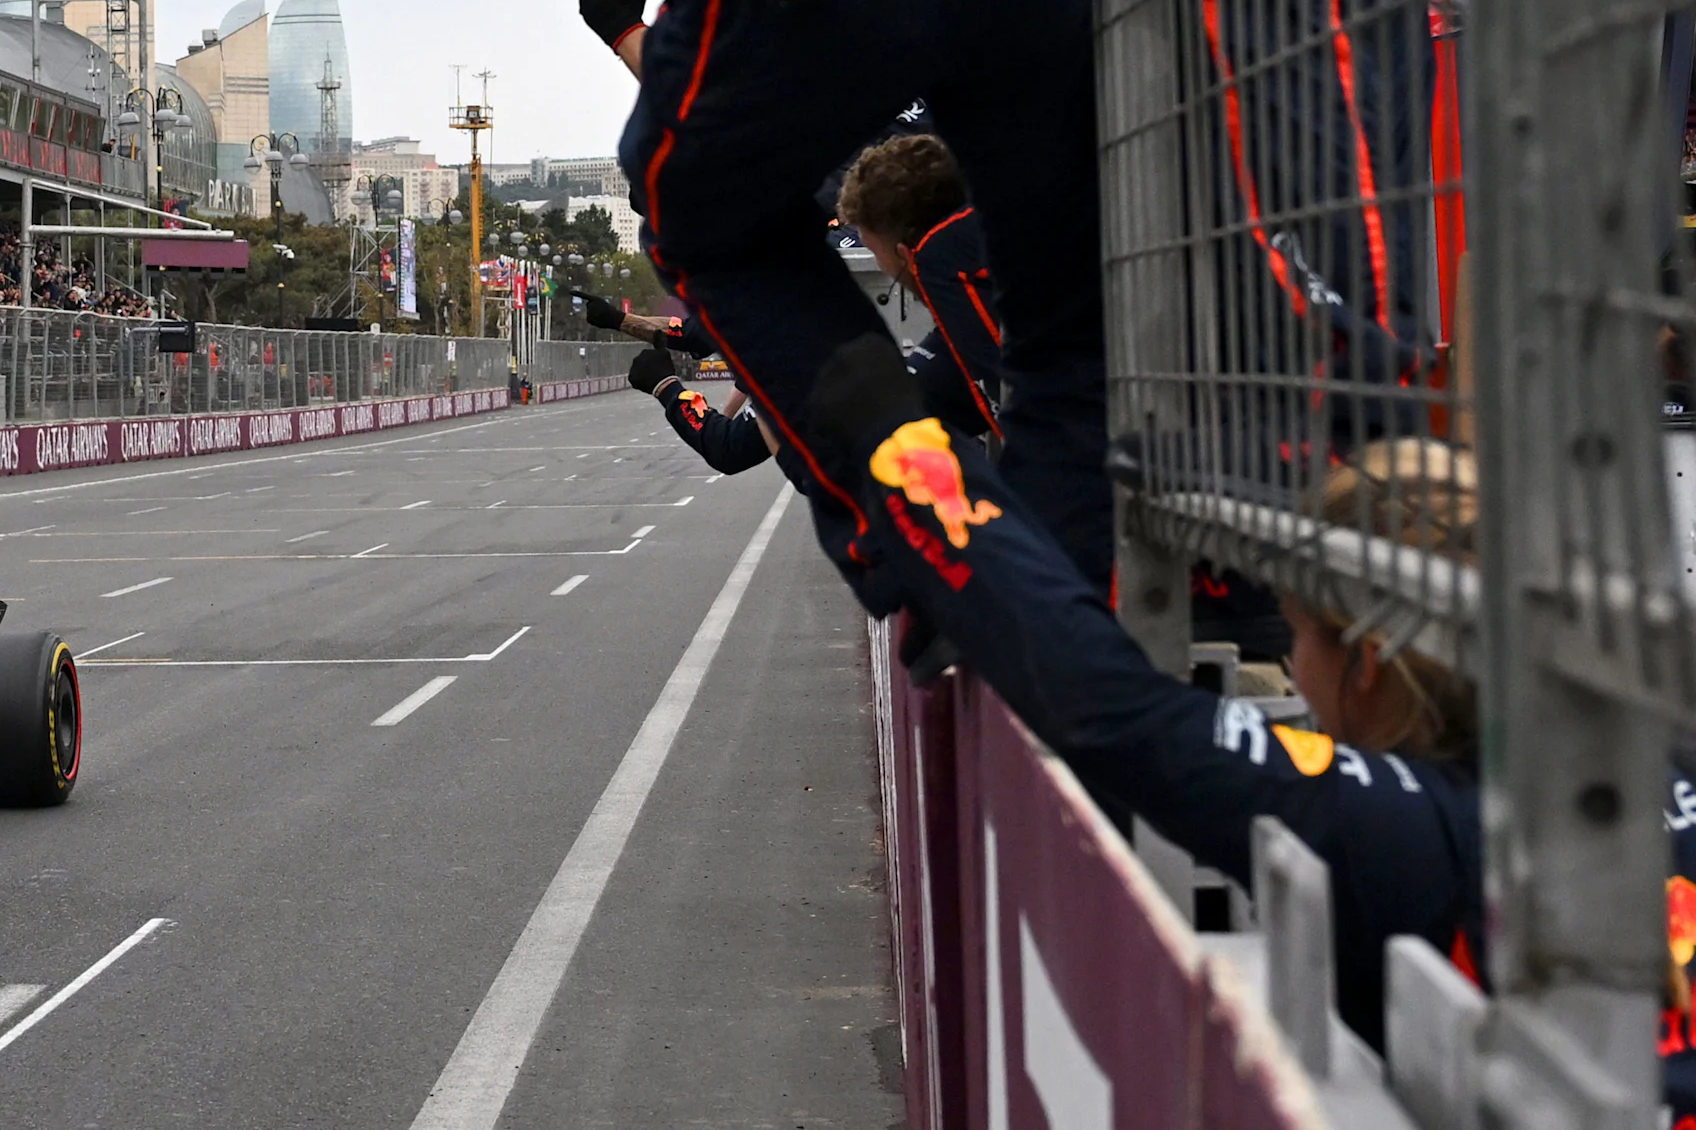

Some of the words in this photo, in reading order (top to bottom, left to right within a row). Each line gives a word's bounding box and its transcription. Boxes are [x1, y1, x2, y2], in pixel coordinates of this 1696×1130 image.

[209, 179, 238, 212] PARK
[36, 426, 69, 468] QATAR
[70, 424, 108, 461] AIRWAYS
[121, 422, 149, 460] QATAR
[150, 421, 180, 453] AIRWAYS
[190, 419, 213, 454] QATAR
[214, 417, 241, 447] AIRWAYS
[249, 416, 268, 447] QATAR
[269, 414, 292, 442] AIRWAYS
